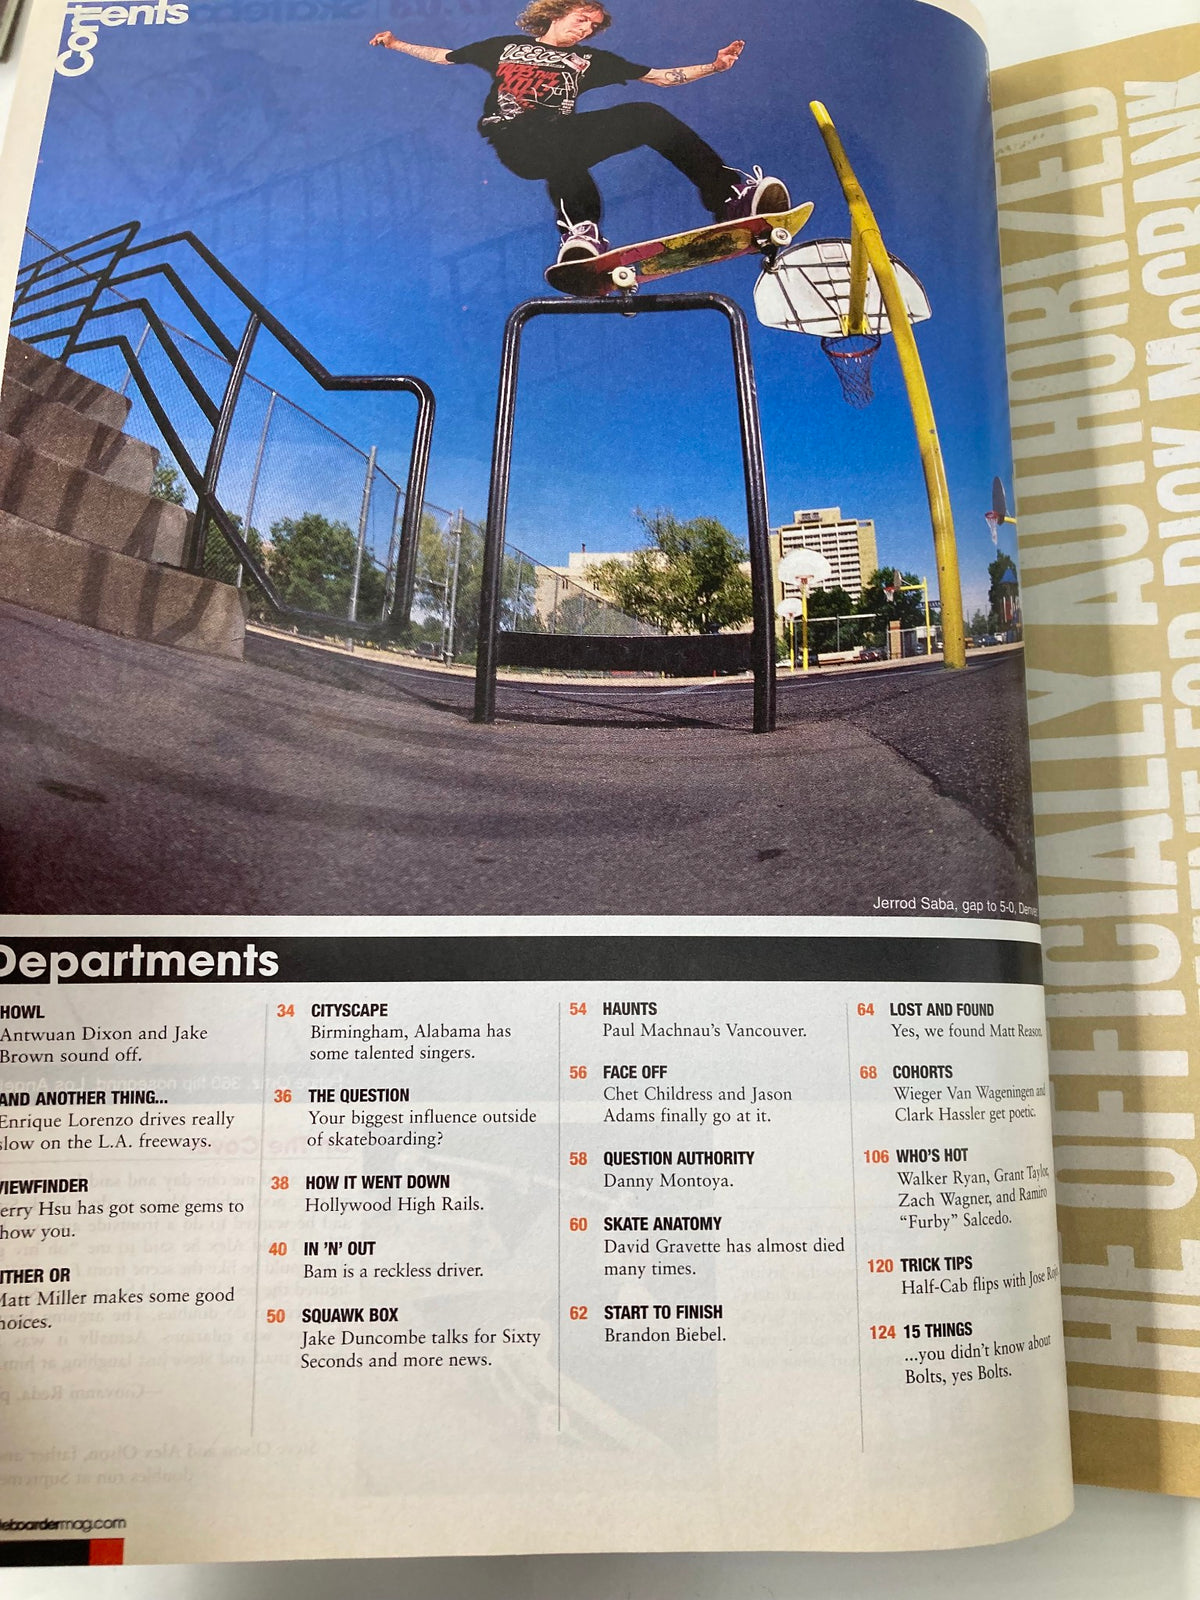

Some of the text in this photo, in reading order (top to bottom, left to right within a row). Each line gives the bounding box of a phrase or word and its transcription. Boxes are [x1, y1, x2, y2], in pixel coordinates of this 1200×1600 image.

[992, 86, 1159, 626] AUTHORIZED
[873, 896, 916, 910] Jerrod
[920, 897, 958, 912] Saba,
[962, 901, 984, 914] gap
[986, 900, 997, 912] to
[999, 901, 1017, 915] 5-0,
[0, 944, 280, 984] Departments
[0, 1005, 45, 1019] HOWL
[277, 1003, 388, 1017] 34 CITYSCAPE
[570, 1002, 657, 1015] 54 HAUNTS
[857, 1003, 994, 1016] 64 LOST AND FOUND
[0, 1025, 207, 1043] Antwuan Dixon and Jake
[603, 1022, 634, 1036] Paul
[726, 1023, 806, 1037] Vancouver.
[891, 1024, 919, 1040] Yes,
[925, 1028, 943, 1037] we
[949, 1023, 985, 1037] found
[990, 1024, 1015, 1037] Matt
[0, 1046, 141, 1063] Brown sound off.
[310, 1045, 474, 1062] some talented singers.
[570, 1065, 667, 1079] 56 FACE OFF
[860, 1065, 953, 1079] 68 COHORTS
[0, 1090, 168, 1106] AND ANOTHER THING...
[275, 1088, 409, 1104] 36 THE QUESTION
[604, 1086, 792, 1104] Chet Childress and Jason
[893, 1083, 1046, 1103] Wieger Van Wageningen and
[0, 1111, 234, 1131] Enrique Lorenzo drives really
[308, 1108, 536, 1128] Your biggest influence outside
[895, 1104, 1036, 1123] Clark Hassler get poetic.
[41, 1140, 60, 1149] on
[68, 1134, 92, 1149] the
[98, 1134, 132, 1148] L.A.
[139, 1133, 211, 1151] freeways.
[570, 1151, 755, 1167] 58 QUESTION AUTHORITY
[865, 1150, 889, 1163] 106
[944, 1148, 968, 1162] HOT
[271, 1176, 289, 1190] 38
[306, 1176, 339, 1189] HOW
[344, 1175, 357, 1189] IT
[361, 1175, 403, 1189] WENT
[407, 1175, 450, 1189] DOWN
[604, 1173, 733, 1191] Danny Montoya.
[897, 1171, 947, 1185] Walker
[953, 1171, 990, 1187] Ryan,
[994, 1168, 1024, 1182] Grant
[898, 1186, 1047, 1208] Zach Wagner, and Ramiro
[39, 1200, 244, 1218] Hsu has got some gems to
[570, 1216, 722, 1231] 60 SKATE ANATOMY
[964, 1211, 1011, 1226] Salcedo.
[41, 1228, 75, 1242] you.
[269, 1242, 287, 1256] 40
[304, 1242, 319, 1256] IN
[348, 1241, 376, 1255] OUT
[604, 1237, 845, 1253] David Gravette has almost died
[869, 1256, 973, 1273] 120 TRICK TIPS
[49, 1268, 70, 1282] OR
[902, 1277, 968, 1294] Half-Cab
[973, 1276, 999, 1293] flips
[1003, 1272, 1026, 1288] with
[1029, 1271, 1045, 1286] Jose
[37, 1286, 234, 1306] Miller makes some good
[267, 1309, 285, 1323] 50
[302, 1308, 364, 1324] SQUAWK
[369, 1308, 398, 1322] BOX
[570, 1305, 723, 1320] 62 START TO FINISH
[605, 1326, 726, 1342] Brandon Biebel.
[870, 1322, 972, 1339] 124 15 THINGS
[905, 1350, 945, 1364] ...you
[994, 1341, 1024, 1355] know
[1028, 1335, 1050, 1350] about
[905, 1363, 1011, 1386] Bolts, yes Bolts.
